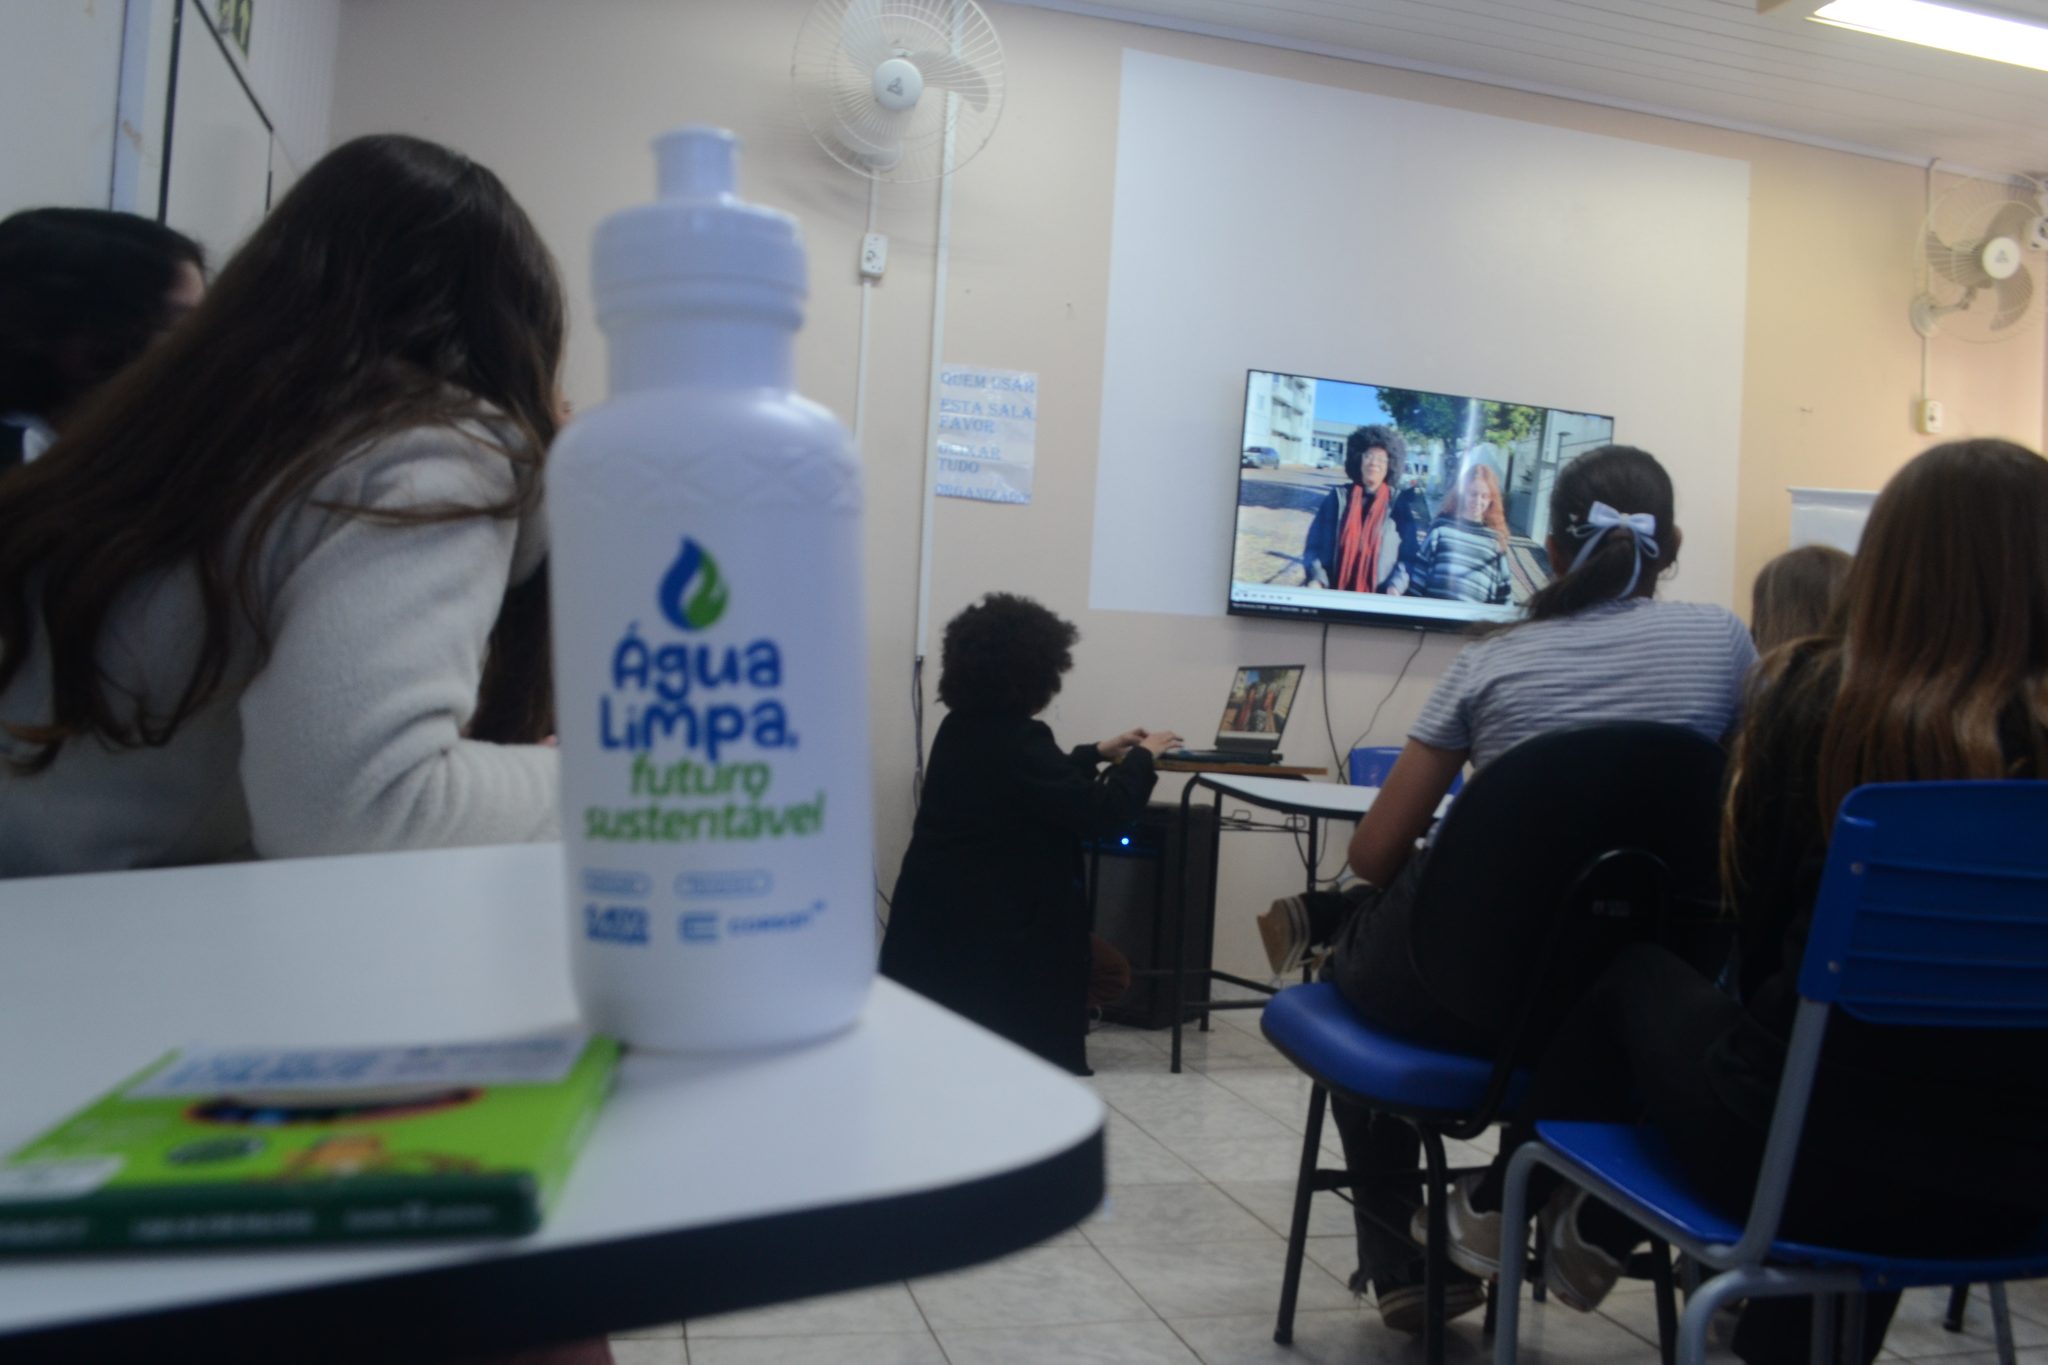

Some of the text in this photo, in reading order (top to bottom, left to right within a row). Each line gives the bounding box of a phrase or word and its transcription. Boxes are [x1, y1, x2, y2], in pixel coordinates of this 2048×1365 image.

[938, 415, 994, 433] FAVOR
[940, 398, 1032, 420] ESTA SALA
[938, 459, 980, 473] TUDO
[614, 622, 782, 700] Água
[631, 753, 770, 797] futuro
[586, 791, 825, 841] sustentável
